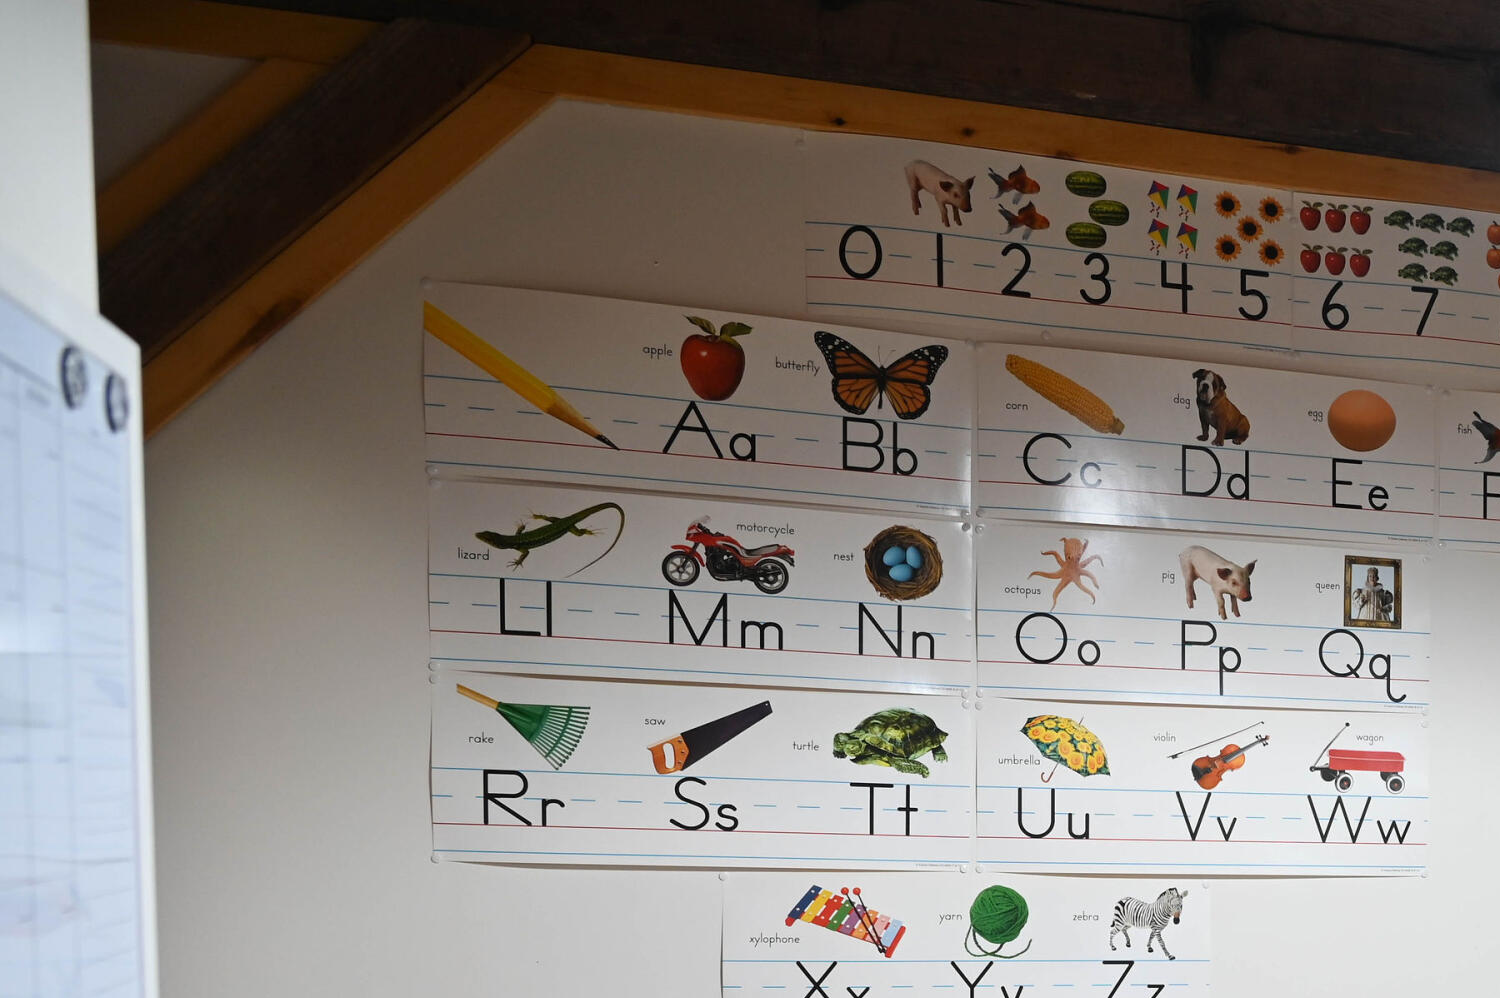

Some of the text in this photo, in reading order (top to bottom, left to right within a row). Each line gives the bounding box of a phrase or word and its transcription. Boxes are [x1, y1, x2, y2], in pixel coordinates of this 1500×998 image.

[839, 225, 1269, 321] 0 1 2 3 4 5
[1322, 281, 1349, 330] 6
[1412, 286, 1438, 336] 7
[643, 344, 672, 359] apple
[776, 357, 820, 376] butterfly
[1174, 393, 1190, 409] dog
[1308, 411, 1323, 422] egg
[1458, 424, 1472, 433] fish
[663, 400, 919, 476] Aa Bb
[1023, 432, 1388, 510] Cc Dd Ee
[737, 523, 794, 537] motorcycle
[458, 548, 489, 560] lizard
[834, 553, 853, 561] nest
[1162, 573, 1175, 584] pig
[1005, 586, 1041, 597] octopus
[1316, 583, 1340, 593] queen
[669, 588, 784, 650] Mm
[859, 603, 934, 659] Nn
[1016, 613, 1406, 702] Oo Pp Qq
[469, 733, 493, 743] rake
[1154, 732, 1176, 742] violin
[1356, 736, 1383, 745] wagon
[793, 741, 819, 750] turtle
[999, 755, 1040, 765] umbrella
[483, 768, 918, 836] Rr Ss Tt
[1018, 788, 1410, 844] Uu Vv Ww
[940, 914, 962, 924] yarn
[1073, 911, 1098, 920] zebra
[750, 933, 800, 946] xylophone
